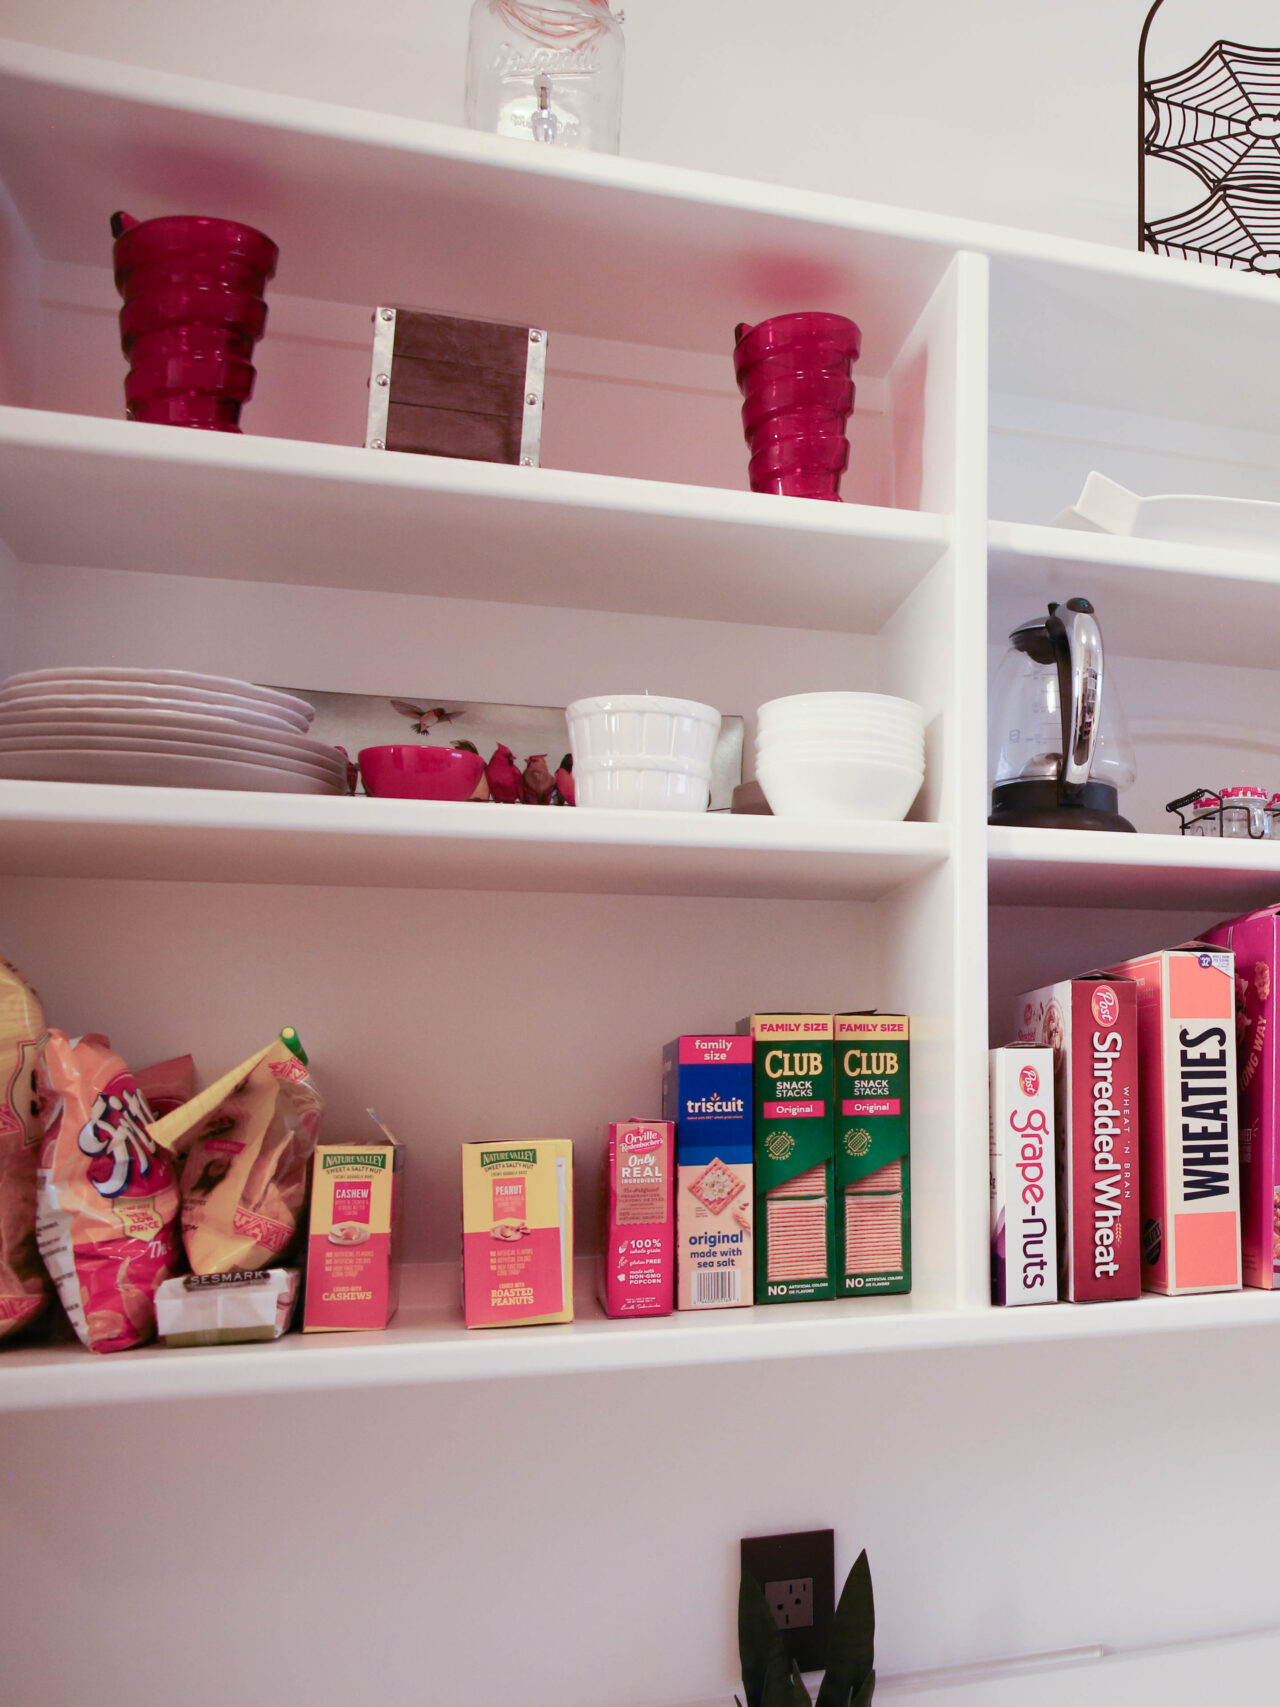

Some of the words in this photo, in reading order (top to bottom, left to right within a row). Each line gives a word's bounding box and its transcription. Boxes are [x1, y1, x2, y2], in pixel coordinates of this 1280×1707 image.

[1096, 991, 1115, 1022] Post
[760, 1023, 801, 1032] FAMILY
[803, 1023, 828, 1032] SIZE
[840, 1023, 878, 1032] FAMILY
[880, 1023, 904, 1032] SIZE
[1253, 1015, 1266, 1052] WAY
[695, 1039, 733, 1051] family
[704, 1050, 727, 1061] size
[764, 1050, 823, 1079] CLUB
[843, 1049, 899, 1077] CLUB
[776, 1081, 812, 1090] SNACK
[854, 1080, 889, 1088] SNACK
[1022, 1069, 1035, 1093] Post
[776, 1089, 813, 1098] STACKS
[854, 1087, 889, 1096] STACKS
[686, 1097, 744, 1113] triscuit
[1093, 1031, 1123, 1171] Shredded
[776, 1105, 813, 1116] Original
[854, 1102, 889, 1114] Original
[1122, 1086, 1131, 1133] WHEAT
[1179, 1027, 1230, 1202] WHEATIES
[625, 1131, 658, 1145] Orville
[620, 1138, 664, 1153] Redenbacher's
[326, 1155, 356, 1168] NATURE
[356, 1155, 383, 1167] VALLEY
[483, 1152, 510, 1165] NATURE
[510, 1150, 534, 1162] VALLEY
[628, 1153, 656, 1168] Only
[326, 1167, 346, 1175] SWEET
[622, 1166, 663, 1178] REAL
[336, 1189, 369, 1199] CASHEW
[495, 1185, 522, 1196] PEANUT
[1009, 1109, 1050, 1289] grape-nuts
[129, 1220, 160, 1233] PRICE
[1094, 1173, 1122, 1278] Wheat
[629, 1239, 662, 1248] 100%
[689, 1230, 744, 1248] original
[690, 1249, 717, 1258] made
[720, 1247, 742, 1257] with
[697, 1260, 714, 1268] sea
[716, 1258, 735, 1267] salt
[190, 1271, 265, 1286] SESMARK
[845, 1277, 864, 1288] NO
[322, 1291, 373, 1301] CASHEWS
[490, 1288, 534, 1298] ROASTED
[768, 1285, 787, 1296] NO
[490, 1296, 535, 1307] PEANUTS
